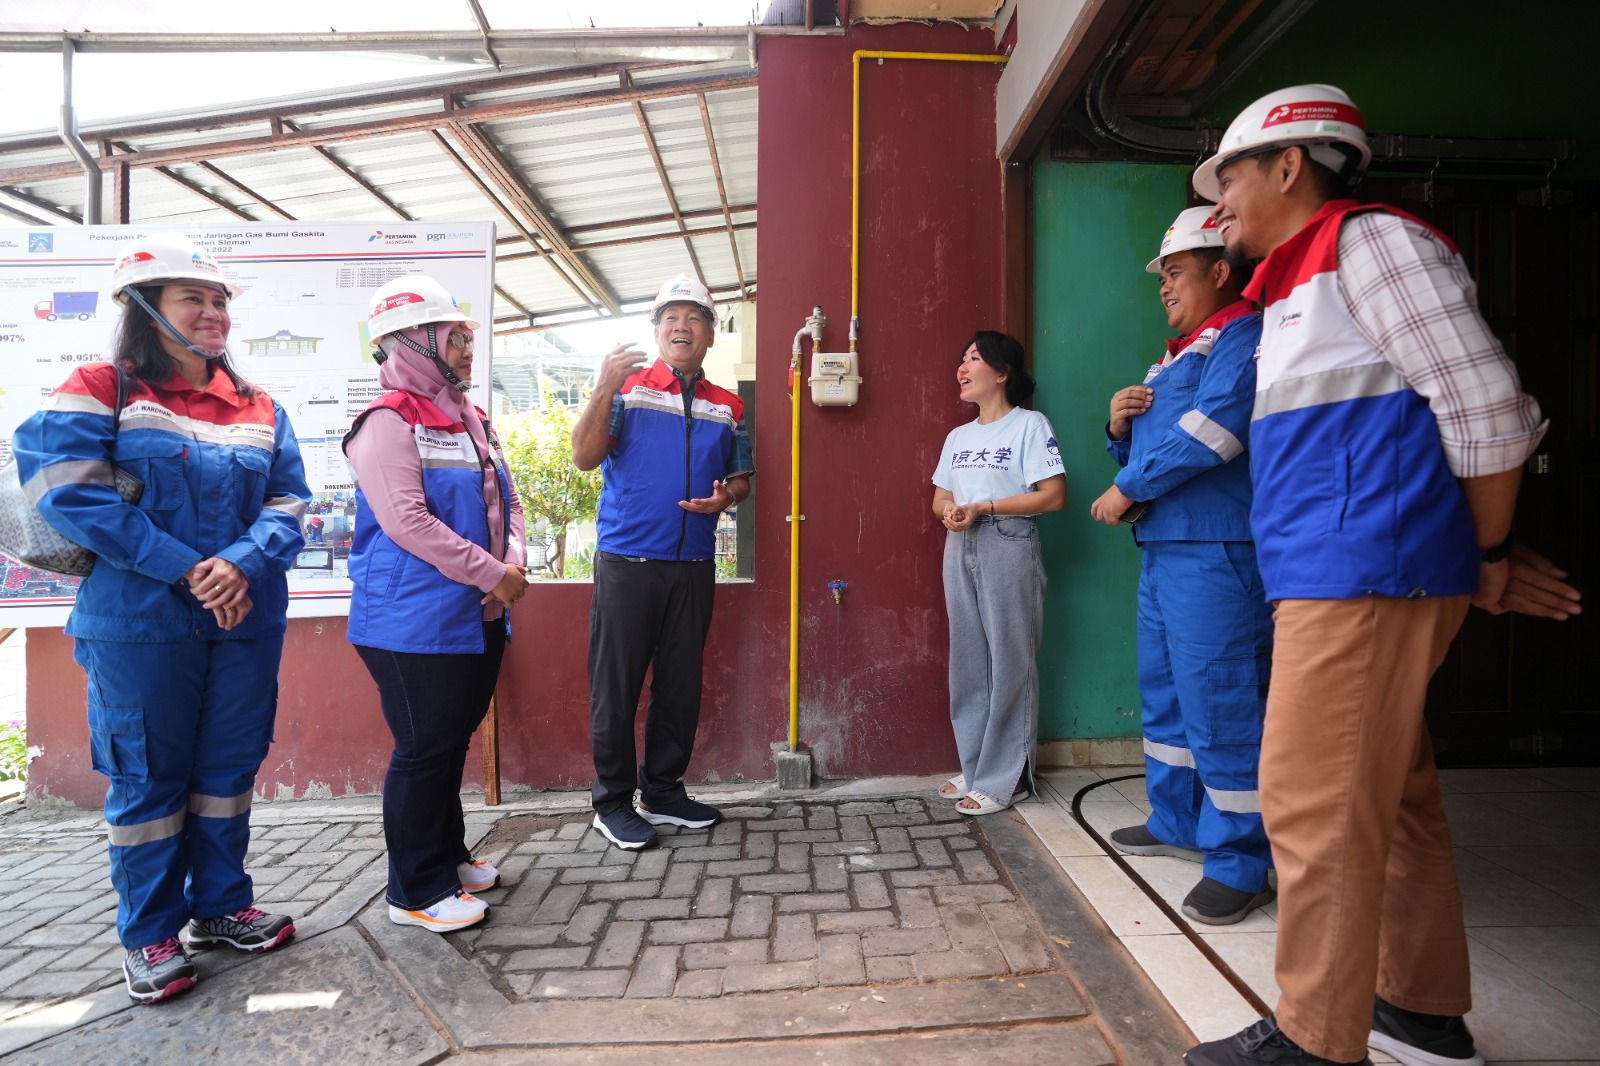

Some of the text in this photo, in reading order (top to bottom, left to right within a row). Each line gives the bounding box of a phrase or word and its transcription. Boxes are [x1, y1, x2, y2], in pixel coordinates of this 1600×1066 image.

[1292, 106, 1338, 114] PERTAMINA
[89, 234, 135, 242] Pekerjaan
[204, 232, 243, 240] Jaringan
[426, 232, 446, 241] pgn
[987, 463, 1009, 471] TOKYO
